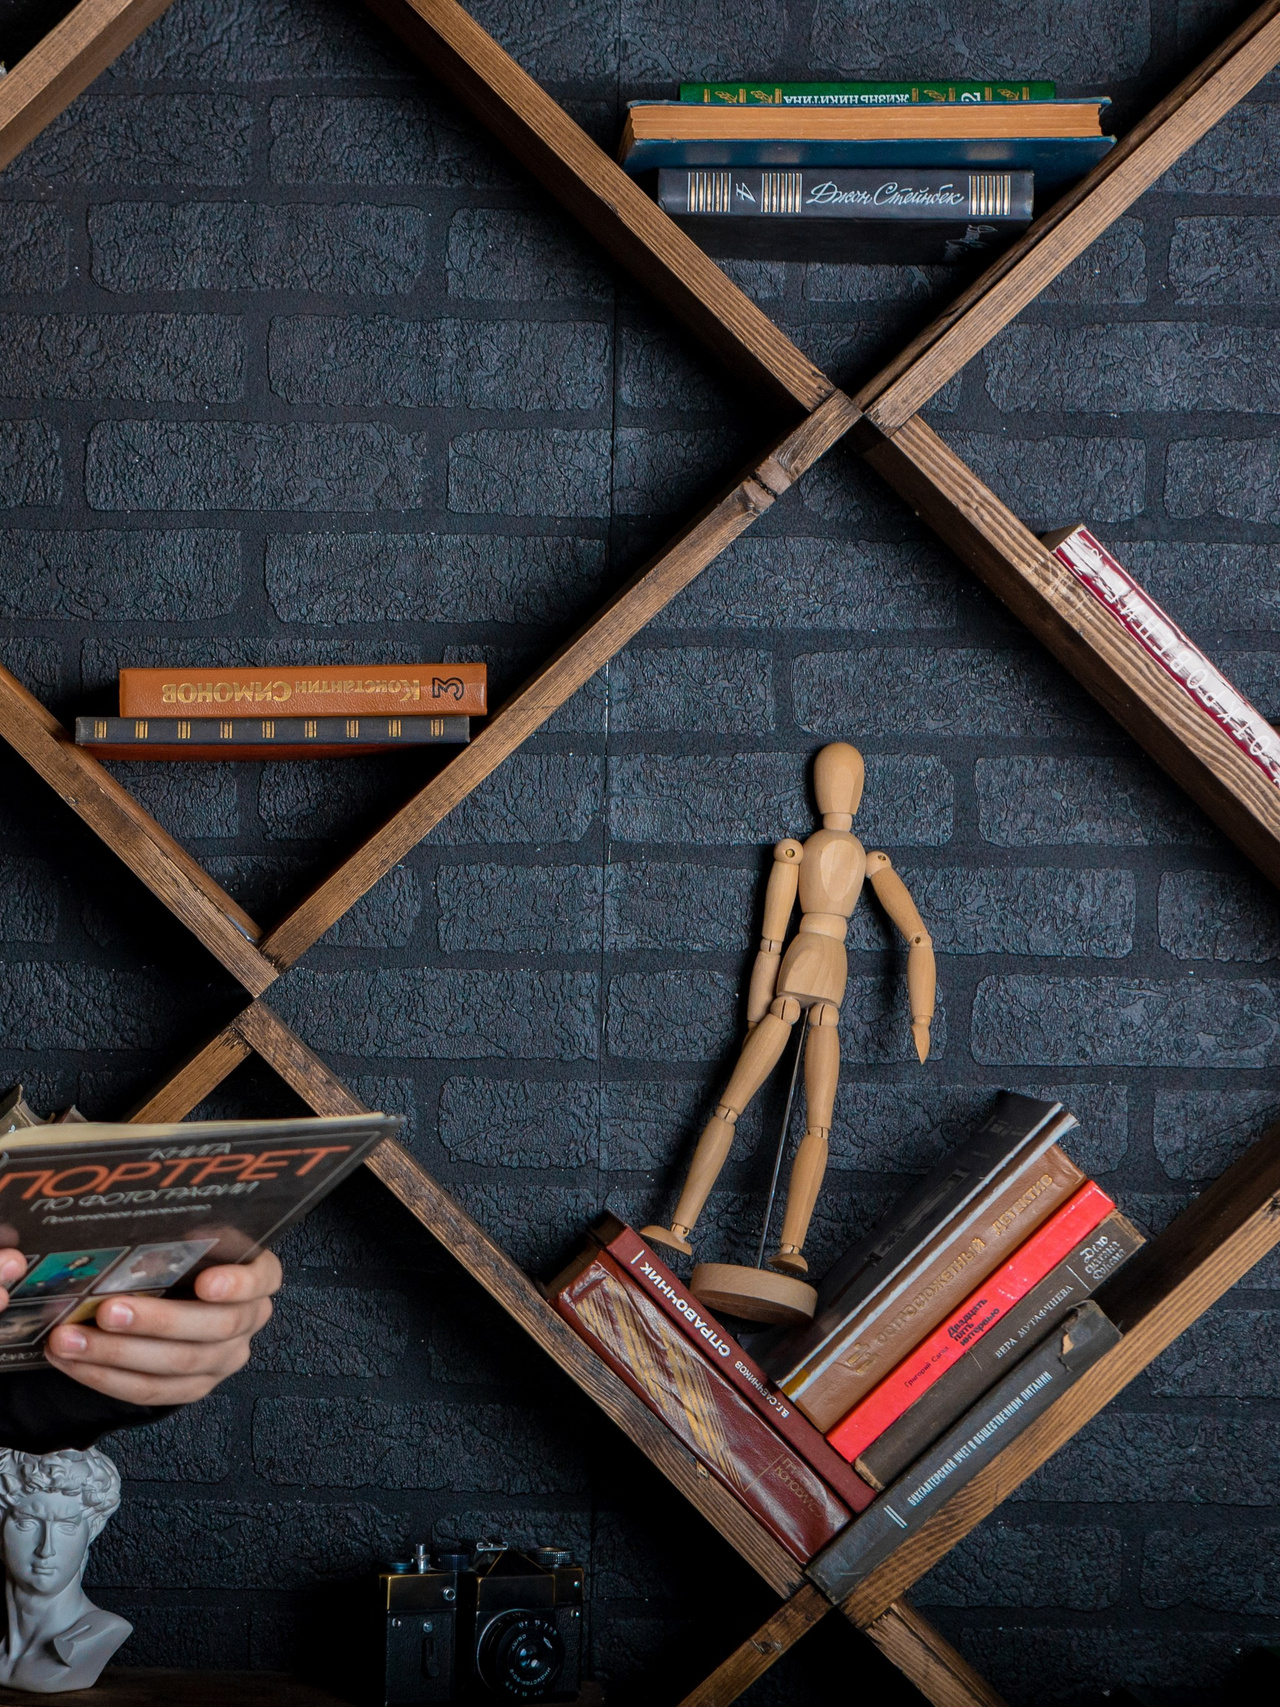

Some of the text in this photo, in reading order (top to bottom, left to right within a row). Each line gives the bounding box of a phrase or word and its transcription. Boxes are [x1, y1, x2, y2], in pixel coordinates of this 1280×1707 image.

[784, 94, 859, 104] НИКИТИНА
[735, 182, 757, 203] 4
[805, 180, 964, 206] Джон Стейнбек
[162, 679, 420, 704] Константин СИМОНОВ
[432, 676, 465, 700] 3
[145, 1142, 236, 1160] КНИГА
[28, 1180, 261, 1212] ПО ФОТОГРАФИИ
[991, 1174, 1052, 1233] ДЕТЕКТИВ
[642, 1261, 729, 1357] СПРАВОЧНИК
[947, 1296, 987, 1336] Двадцать
[960, 1307, 1000, 1346] интервью
[994, 1336, 1017, 1358] ВЕРА
[907, 1459, 957, 1504] БУХГАЛТЕРСКИЙ
[953, 1444, 972, 1463] УЧЕТ
[973, 1397, 1024, 1443] ОБЩЕСТВЕННОМ
